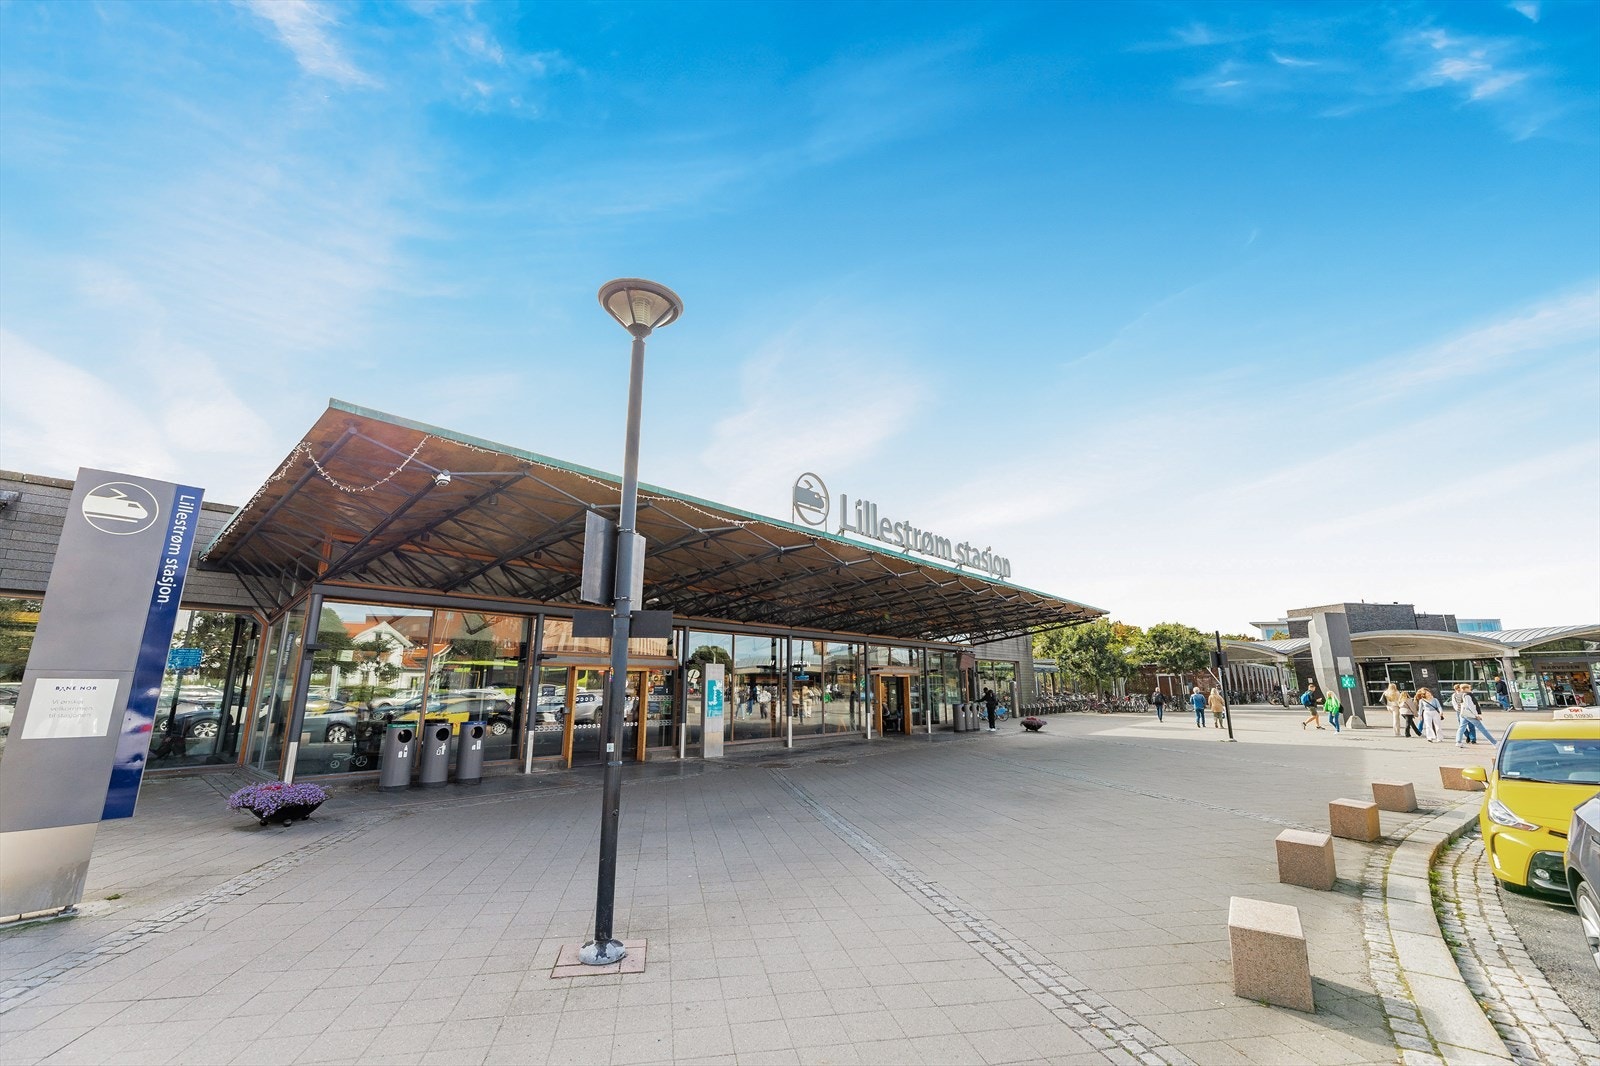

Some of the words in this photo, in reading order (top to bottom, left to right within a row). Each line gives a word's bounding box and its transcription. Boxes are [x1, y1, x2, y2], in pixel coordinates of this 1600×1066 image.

[168, 494, 196, 555] Lillestrøm
[840, 493, 952, 562] Lillestrøm
[954, 539, 1011, 578] stasjon
[157, 558, 179, 603] stasjon
